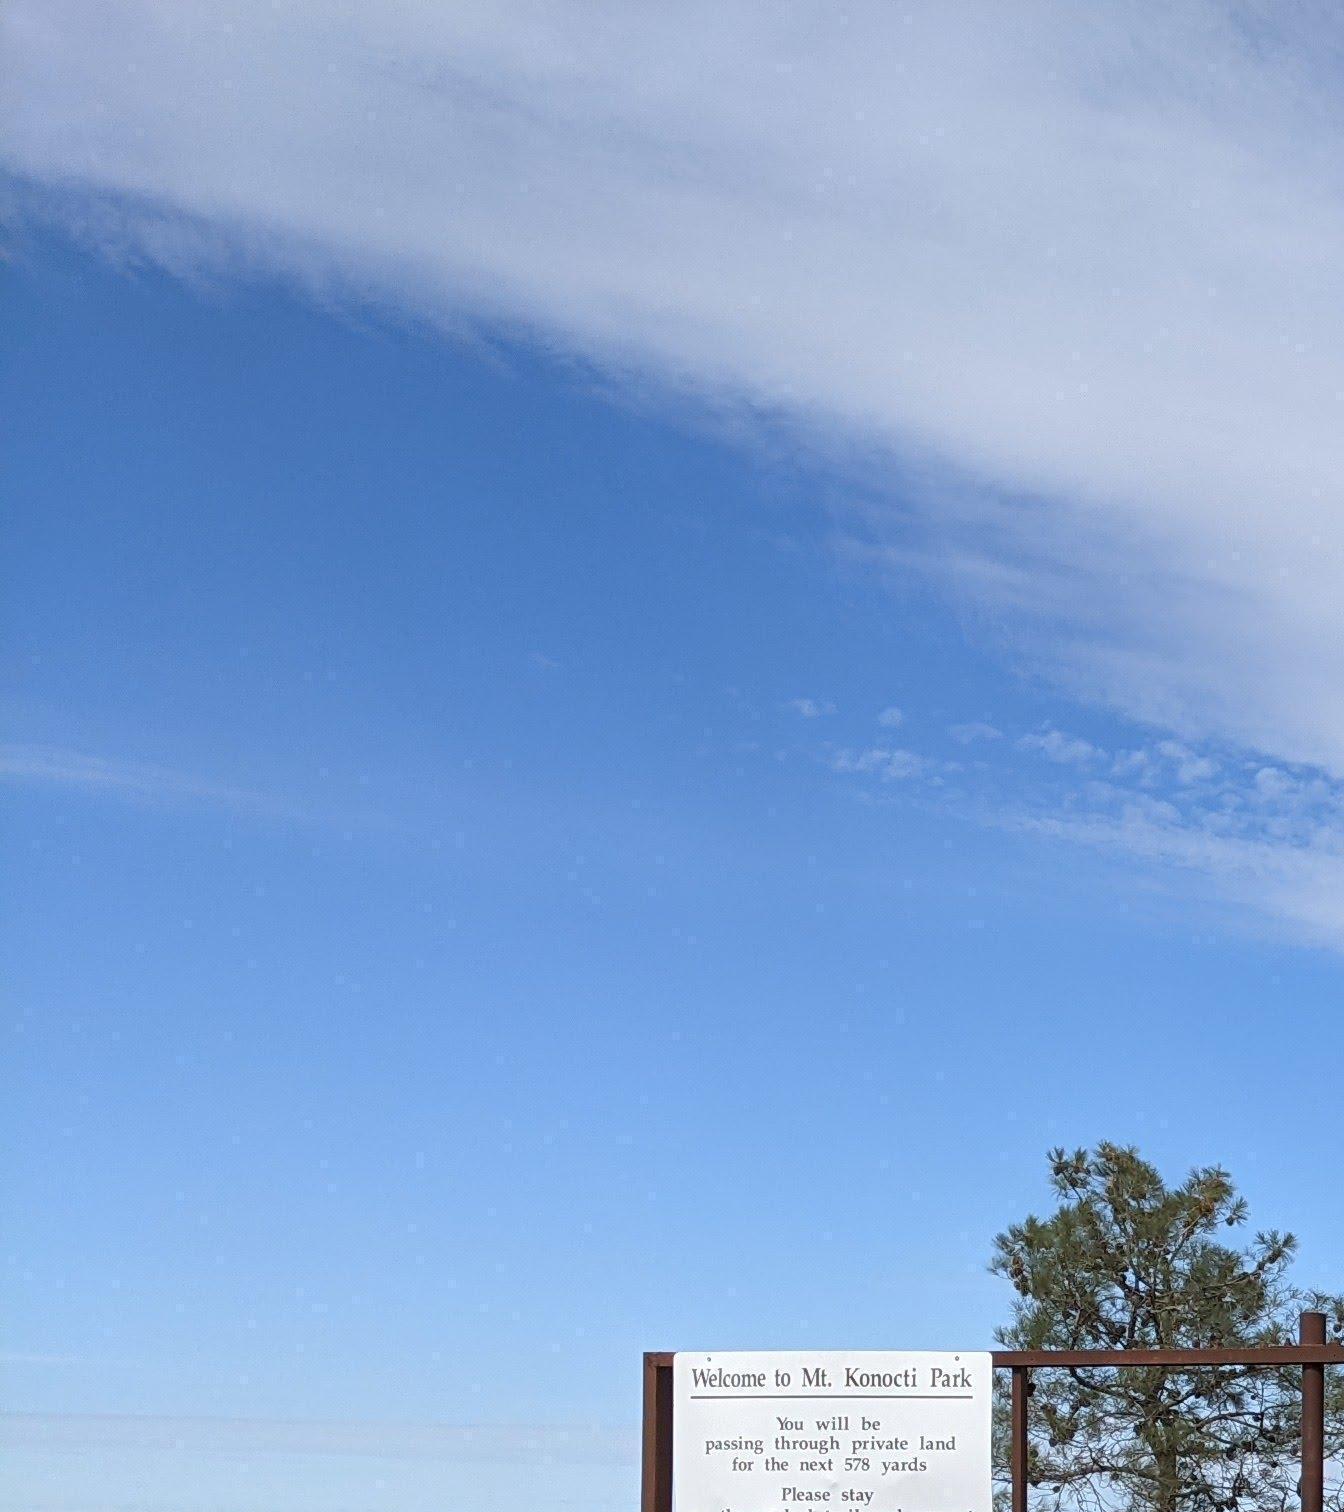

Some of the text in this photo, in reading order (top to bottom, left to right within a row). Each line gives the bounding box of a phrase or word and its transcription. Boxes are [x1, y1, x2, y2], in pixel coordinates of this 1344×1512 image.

[692, 1367, 972, 1388] Welcome to Mt. Konocti Park
[776, 1416, 881, 1431] You will be
[705, 1436, 955, 1454] passing through private land
[732, 1457, 927, 1476] for the next 578 yards
[782, 1487, 874, 1505] Please stay
